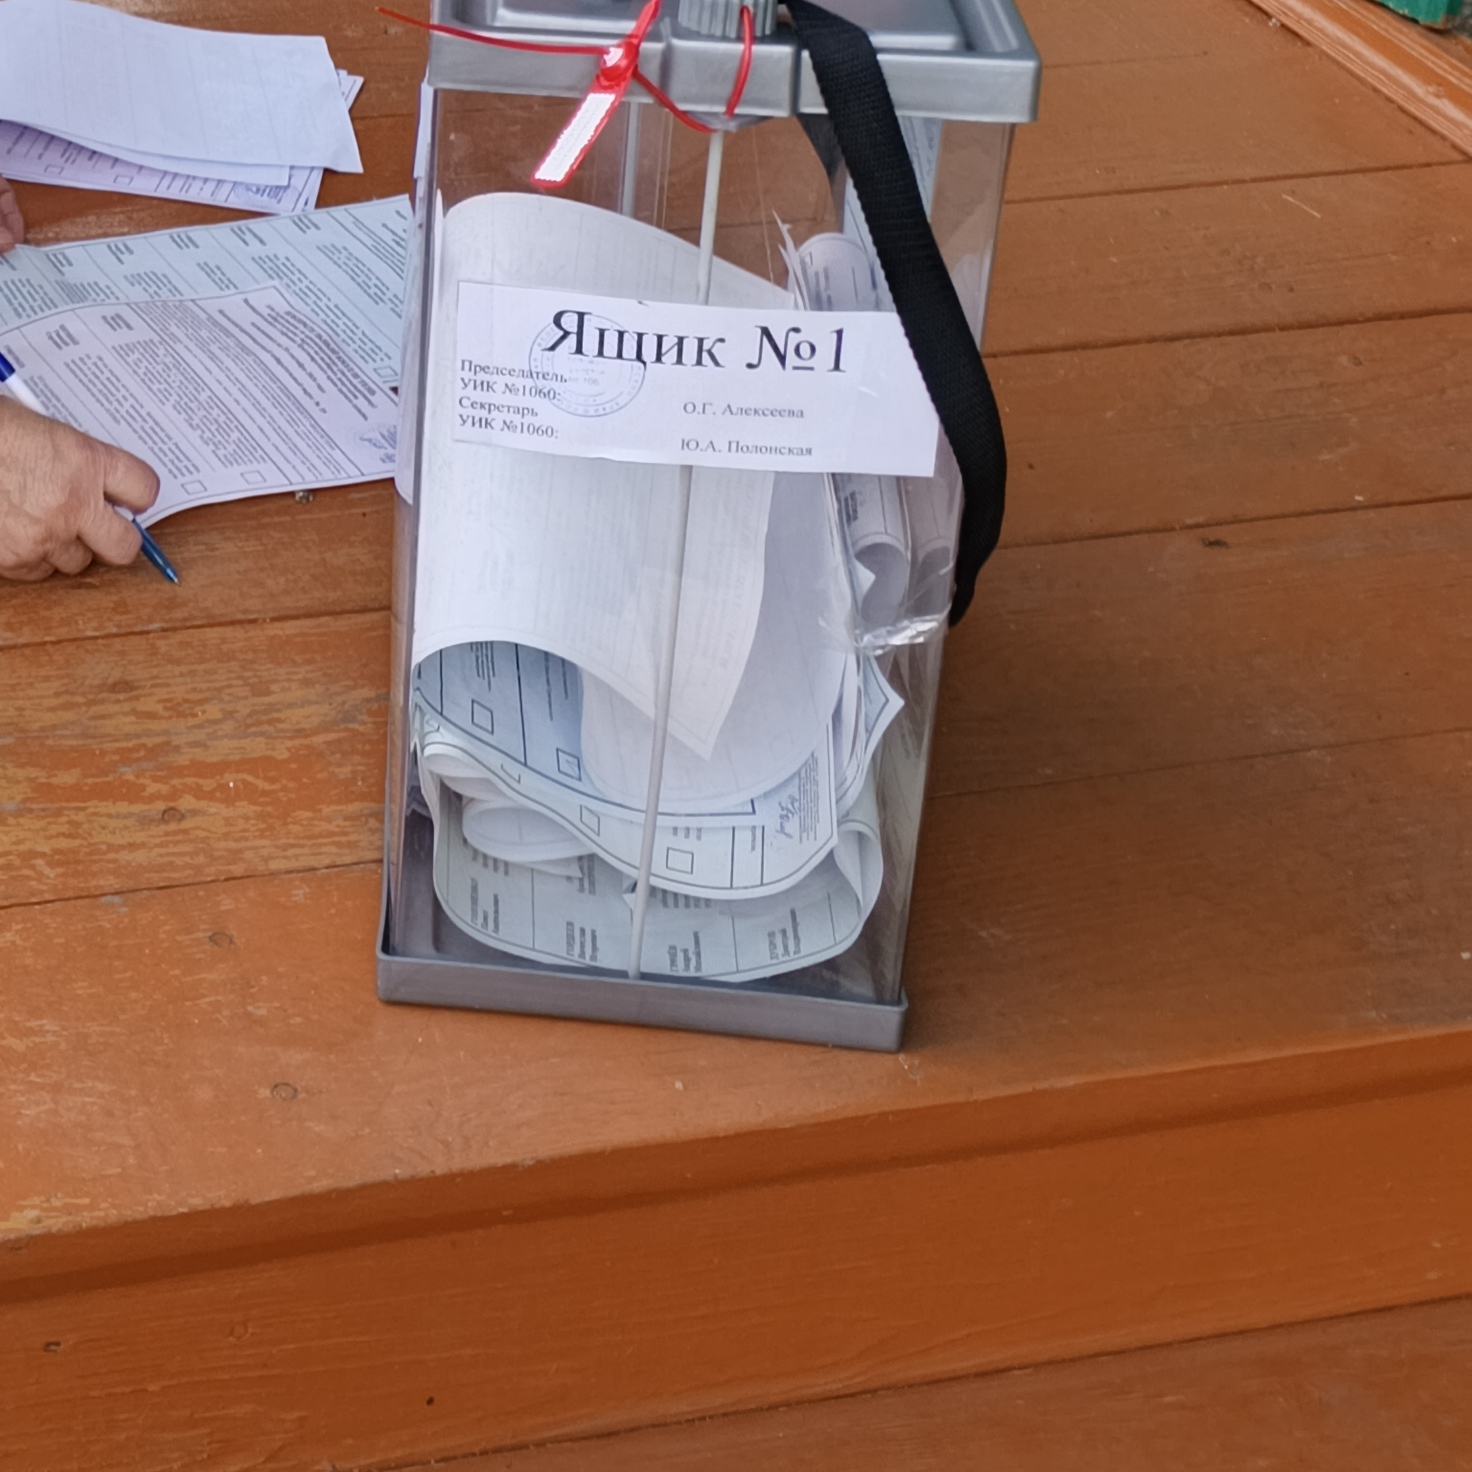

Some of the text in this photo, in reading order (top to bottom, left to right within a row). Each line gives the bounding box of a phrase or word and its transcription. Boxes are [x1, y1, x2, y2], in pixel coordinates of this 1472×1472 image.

[540, 309, 847, 373] Ящик №1
[460, 359, 568, 384] Председатель
[460, 377, 561, 402] УИК №1060:
[458, 395, 539, 418] Секретарь
[683, 402, 805, 419] О.Г. Алексеева
[458, 413, 559, 439] УИК №1060:
[680, 438, 813, 457] Ю.А. Полонская
